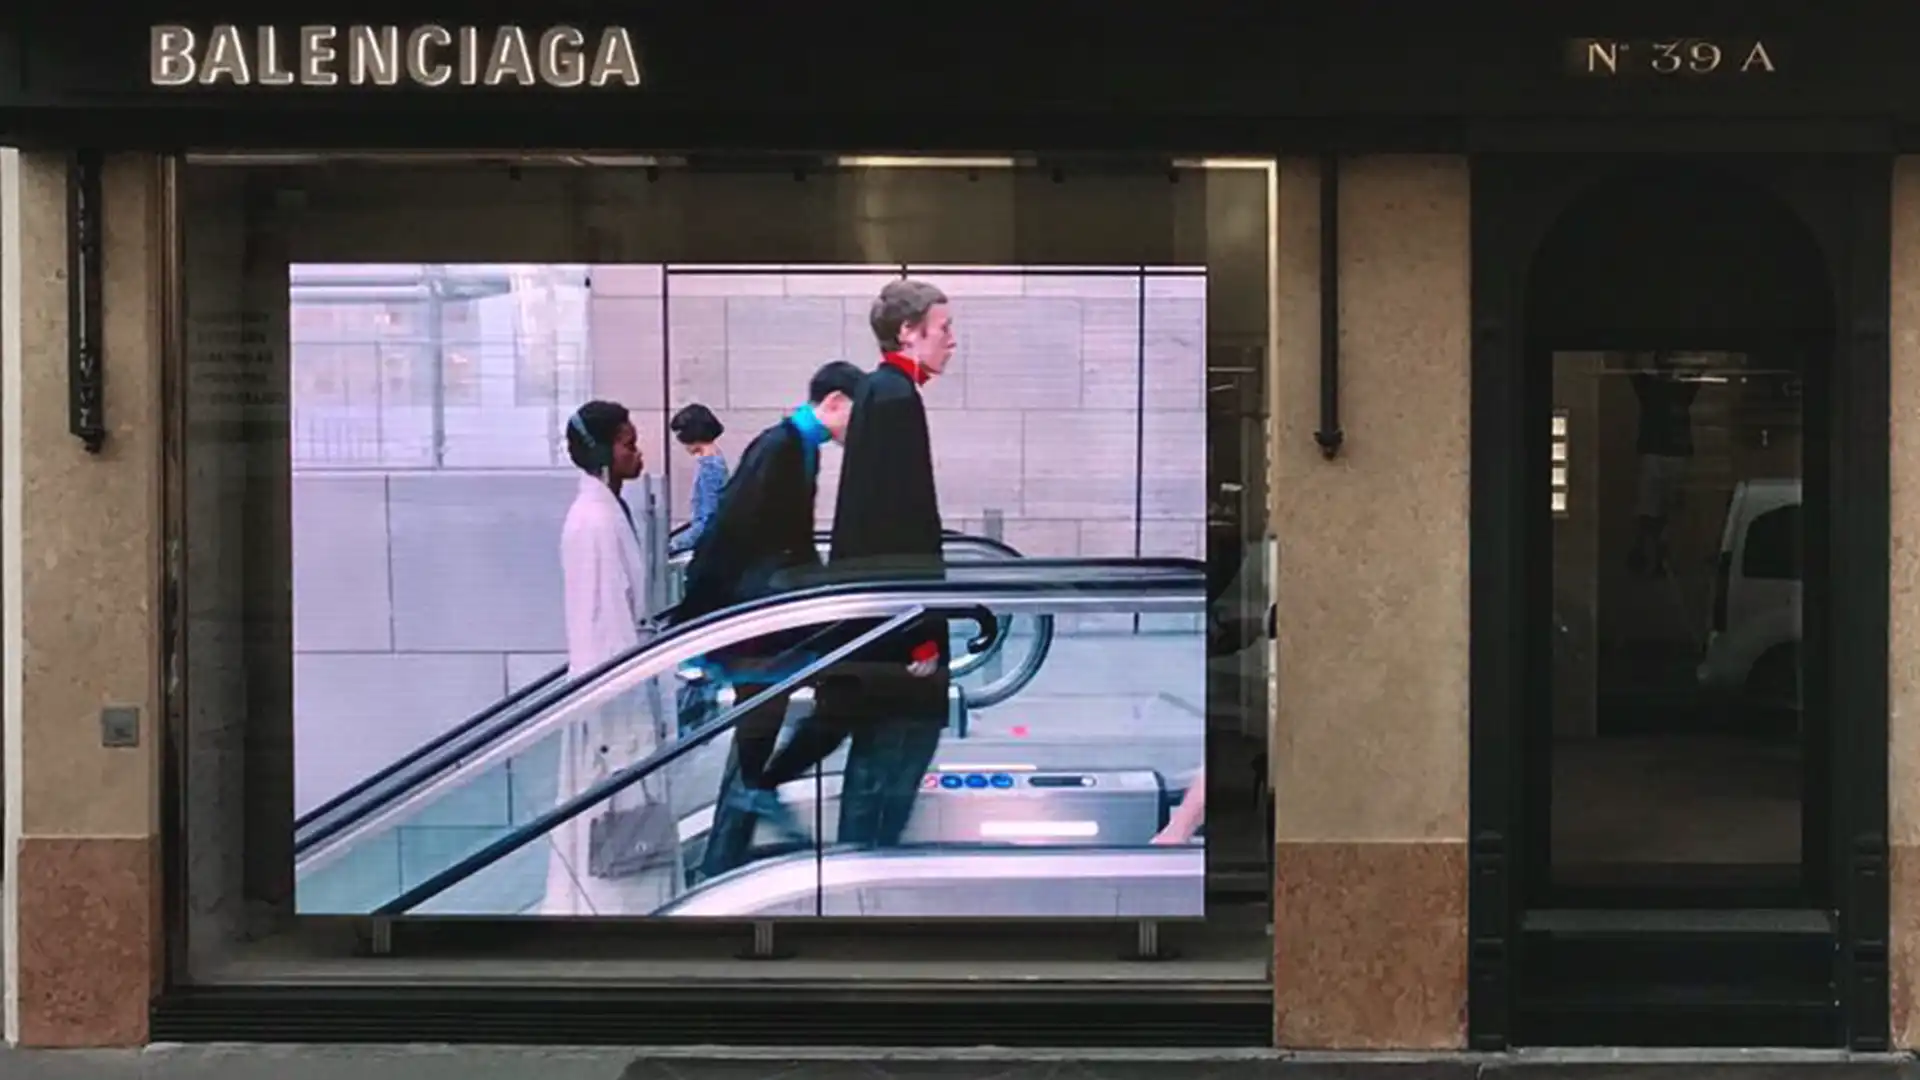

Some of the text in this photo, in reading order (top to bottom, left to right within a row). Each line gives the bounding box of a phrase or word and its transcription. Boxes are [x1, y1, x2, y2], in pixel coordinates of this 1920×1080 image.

[150, 24, 641, 87] BALENCIAGA
[1651, 41, 1722, 74] 39
[1740, 41, 1776, 73] A
